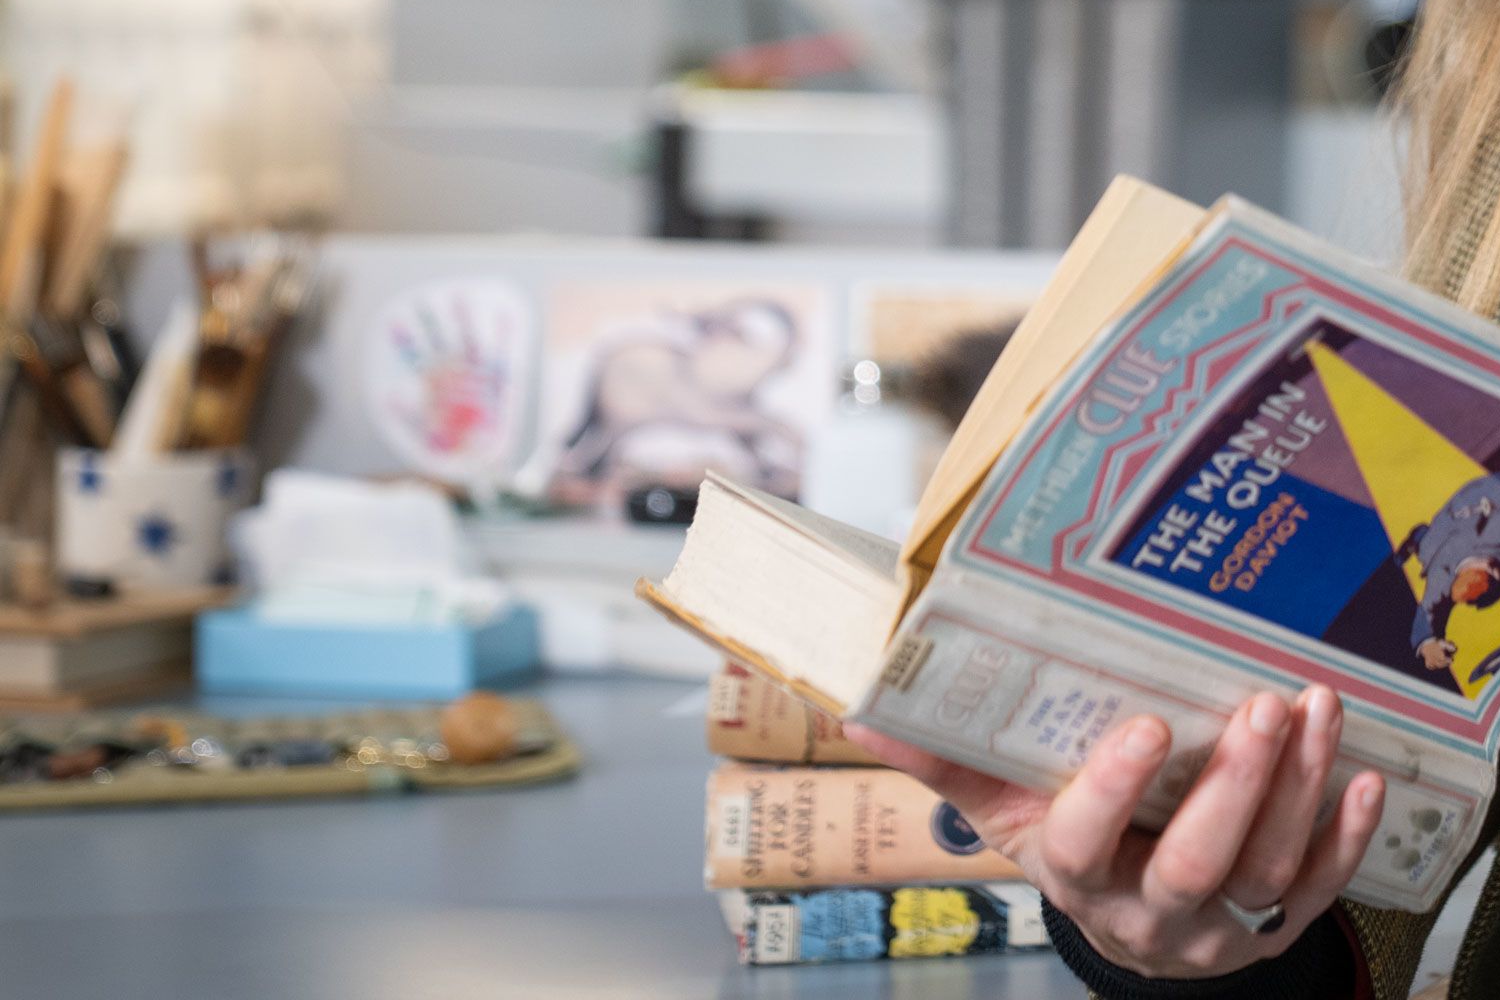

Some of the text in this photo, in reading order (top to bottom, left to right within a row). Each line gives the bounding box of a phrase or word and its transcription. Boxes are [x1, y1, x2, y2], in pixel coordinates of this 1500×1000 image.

[1076, 341, 1181, 435] CLUE
[1158, 255, 1268, 350] STORIES
[1131, 381, 1306, 569] THE MAN IN
[1169, 409, 1327, 573] THE QUEUE
[1209, 492, 1295, 593] GORDON
[1234, 504, 1308, 591] DAVIOT
[934, 644, 1010, 730] CLUE
[1037, 689, 1083, 744] MAN
[768, 801, 788, 850] FOR
[791, 779, 816, 878] CANDLES
[878, 805, 898, 849] TEY
